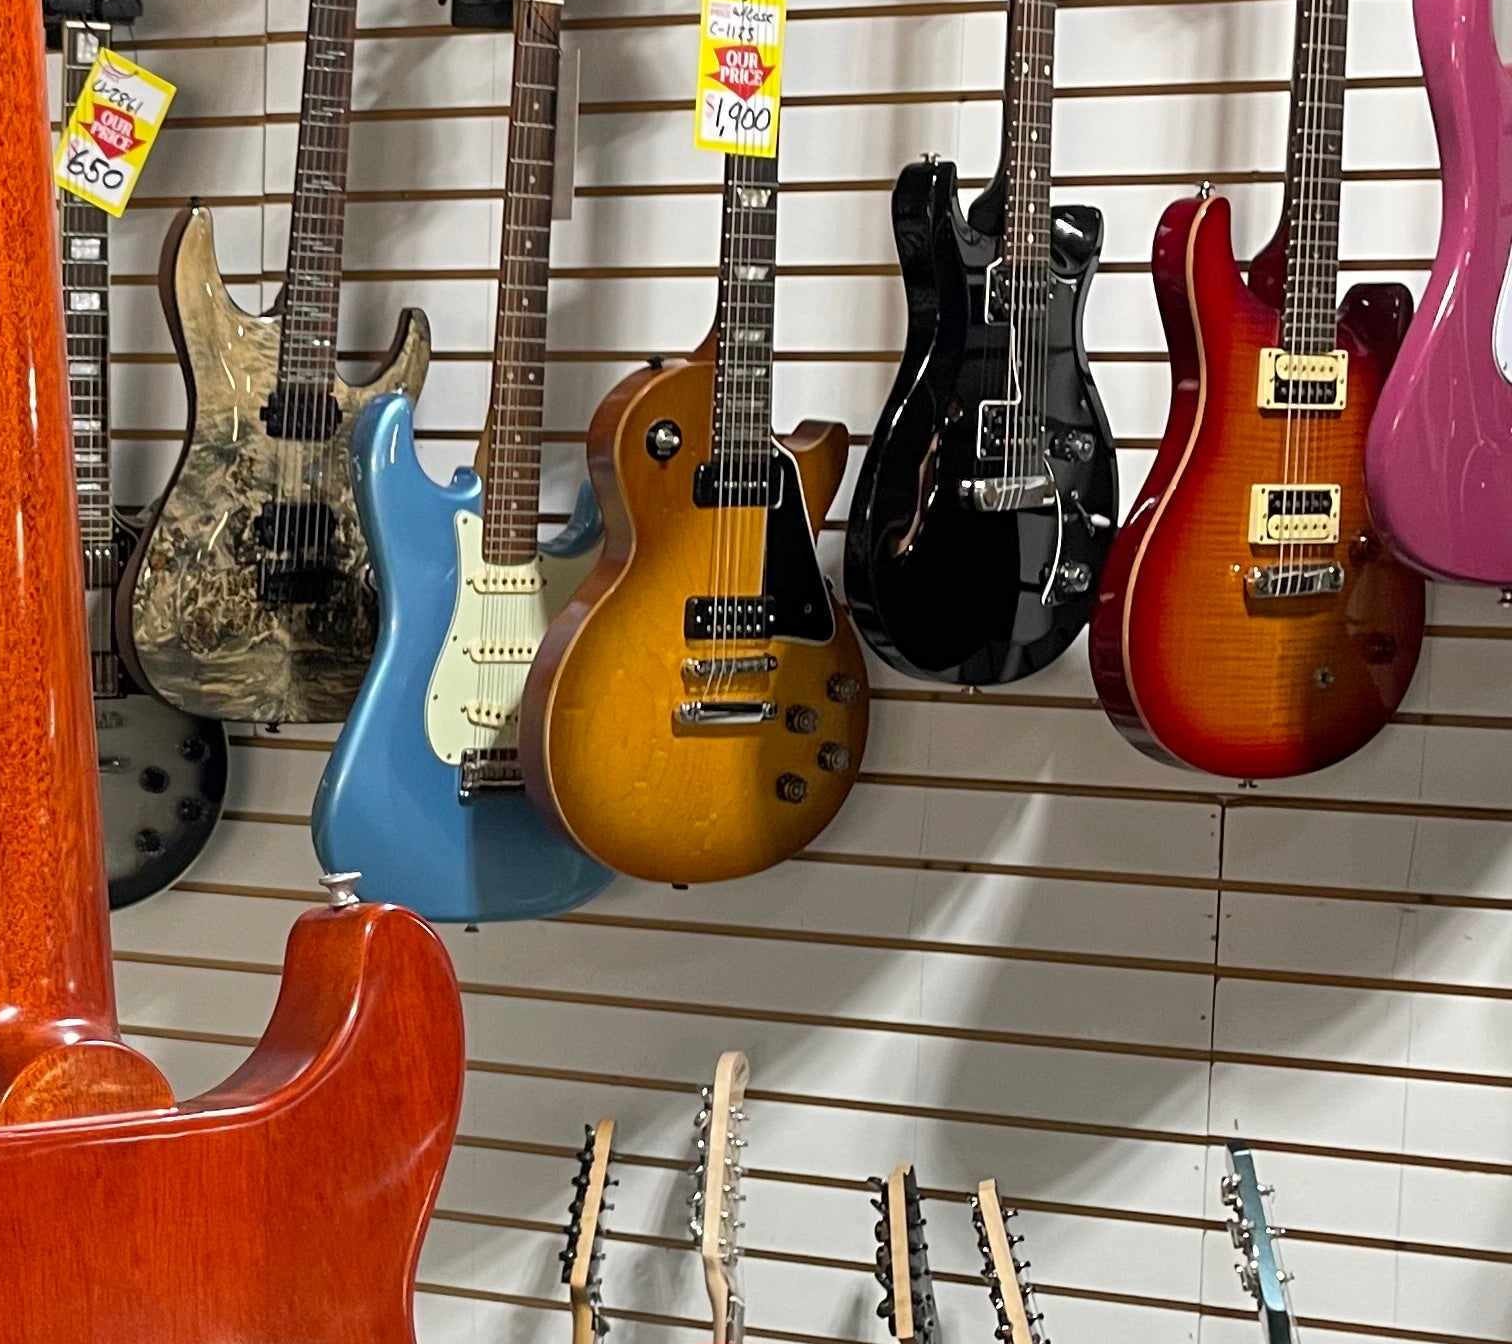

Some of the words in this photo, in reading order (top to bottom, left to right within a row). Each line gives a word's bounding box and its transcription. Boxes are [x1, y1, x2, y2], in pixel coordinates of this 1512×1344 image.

[726, 49, 759, 69] OUR
[719, 65, 765, 87] PRICE
[90, 120, 134, 153] PRICE
[100, 110, 134, 138] OUR
